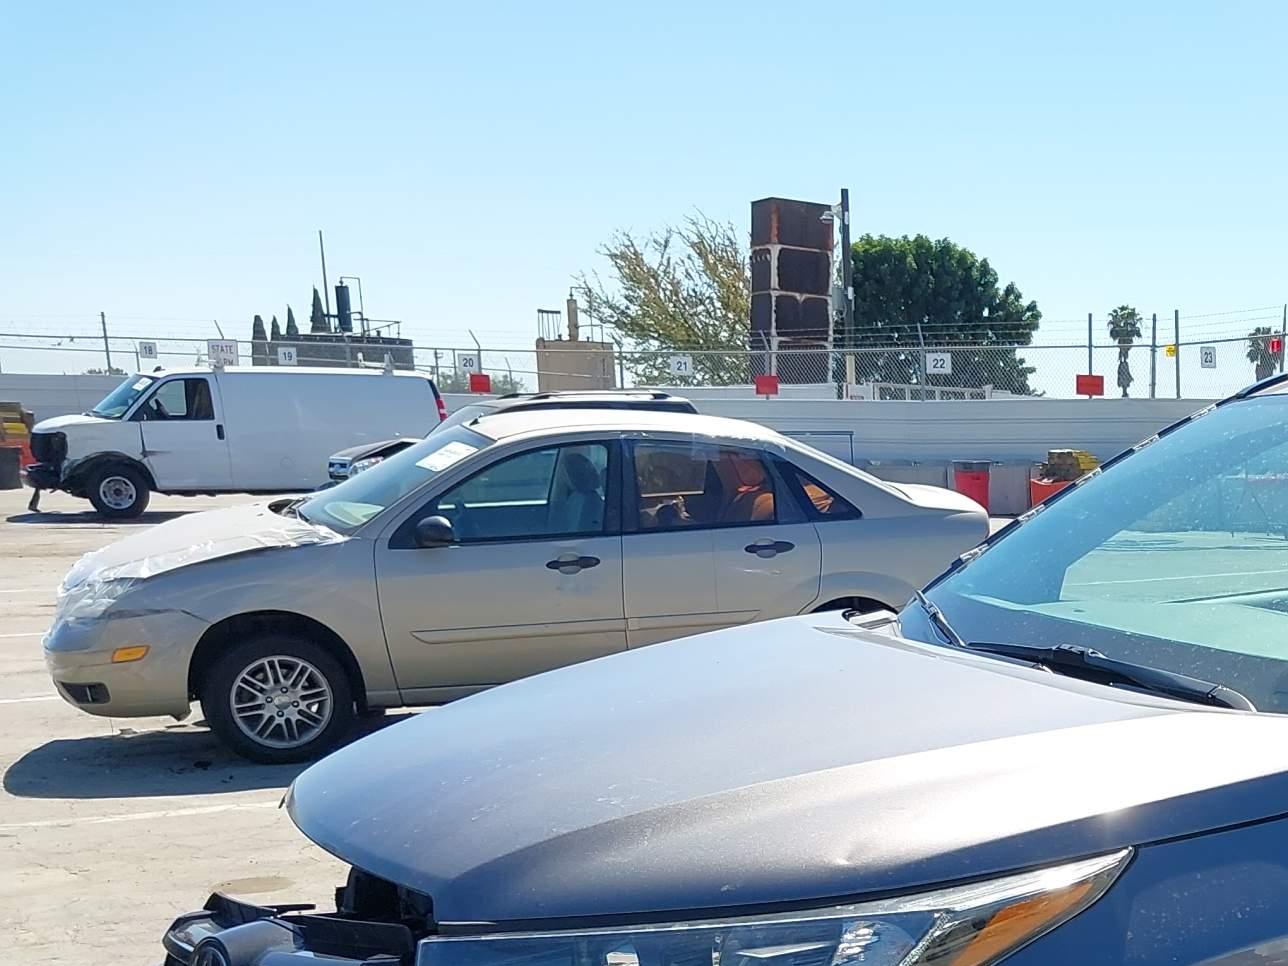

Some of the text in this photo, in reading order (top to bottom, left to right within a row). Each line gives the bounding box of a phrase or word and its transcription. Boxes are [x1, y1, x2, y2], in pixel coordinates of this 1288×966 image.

[283, 351, 293, 361] 19
[1204, 351, 1213, 363] 23
[462, 357, 474, 368] 20
[676, 360, 687, 371] 21
[932, 358, 946, 369] 22
